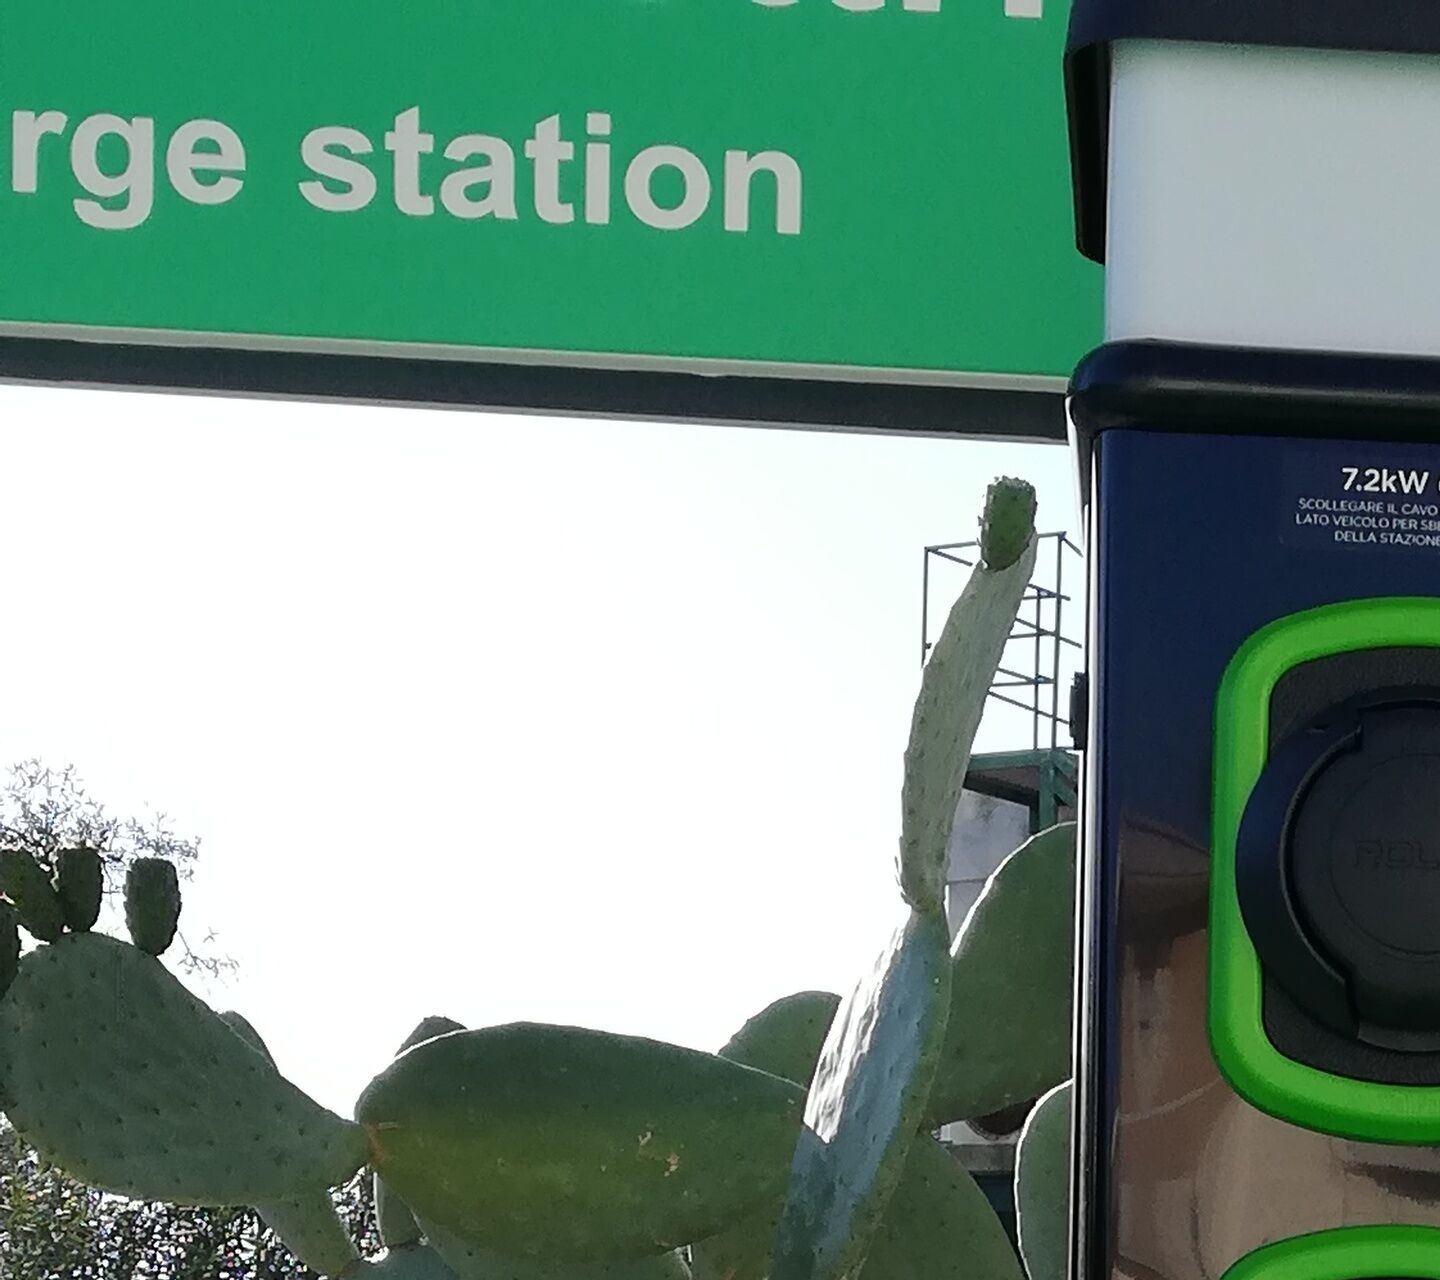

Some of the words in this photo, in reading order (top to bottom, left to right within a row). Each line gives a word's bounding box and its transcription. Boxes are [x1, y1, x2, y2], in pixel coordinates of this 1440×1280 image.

[11, 108, 247, 231] rge
[297, 106, 802, 236] station
[1342, 466, 1430, 495] 7.2kW
[1298, 498, 1384, 514] SCOLLEGARE
[1387, 503, 1399, 514] IL
[1401, 503, 1438, 517] CAVO
[1295, 513, 1330, 526] LATO
[1332, 514, 1390, 529] VEICOLO
[1392, 518, 1418, 530] PER
[1334, 530, 1377, 543] DELLA
